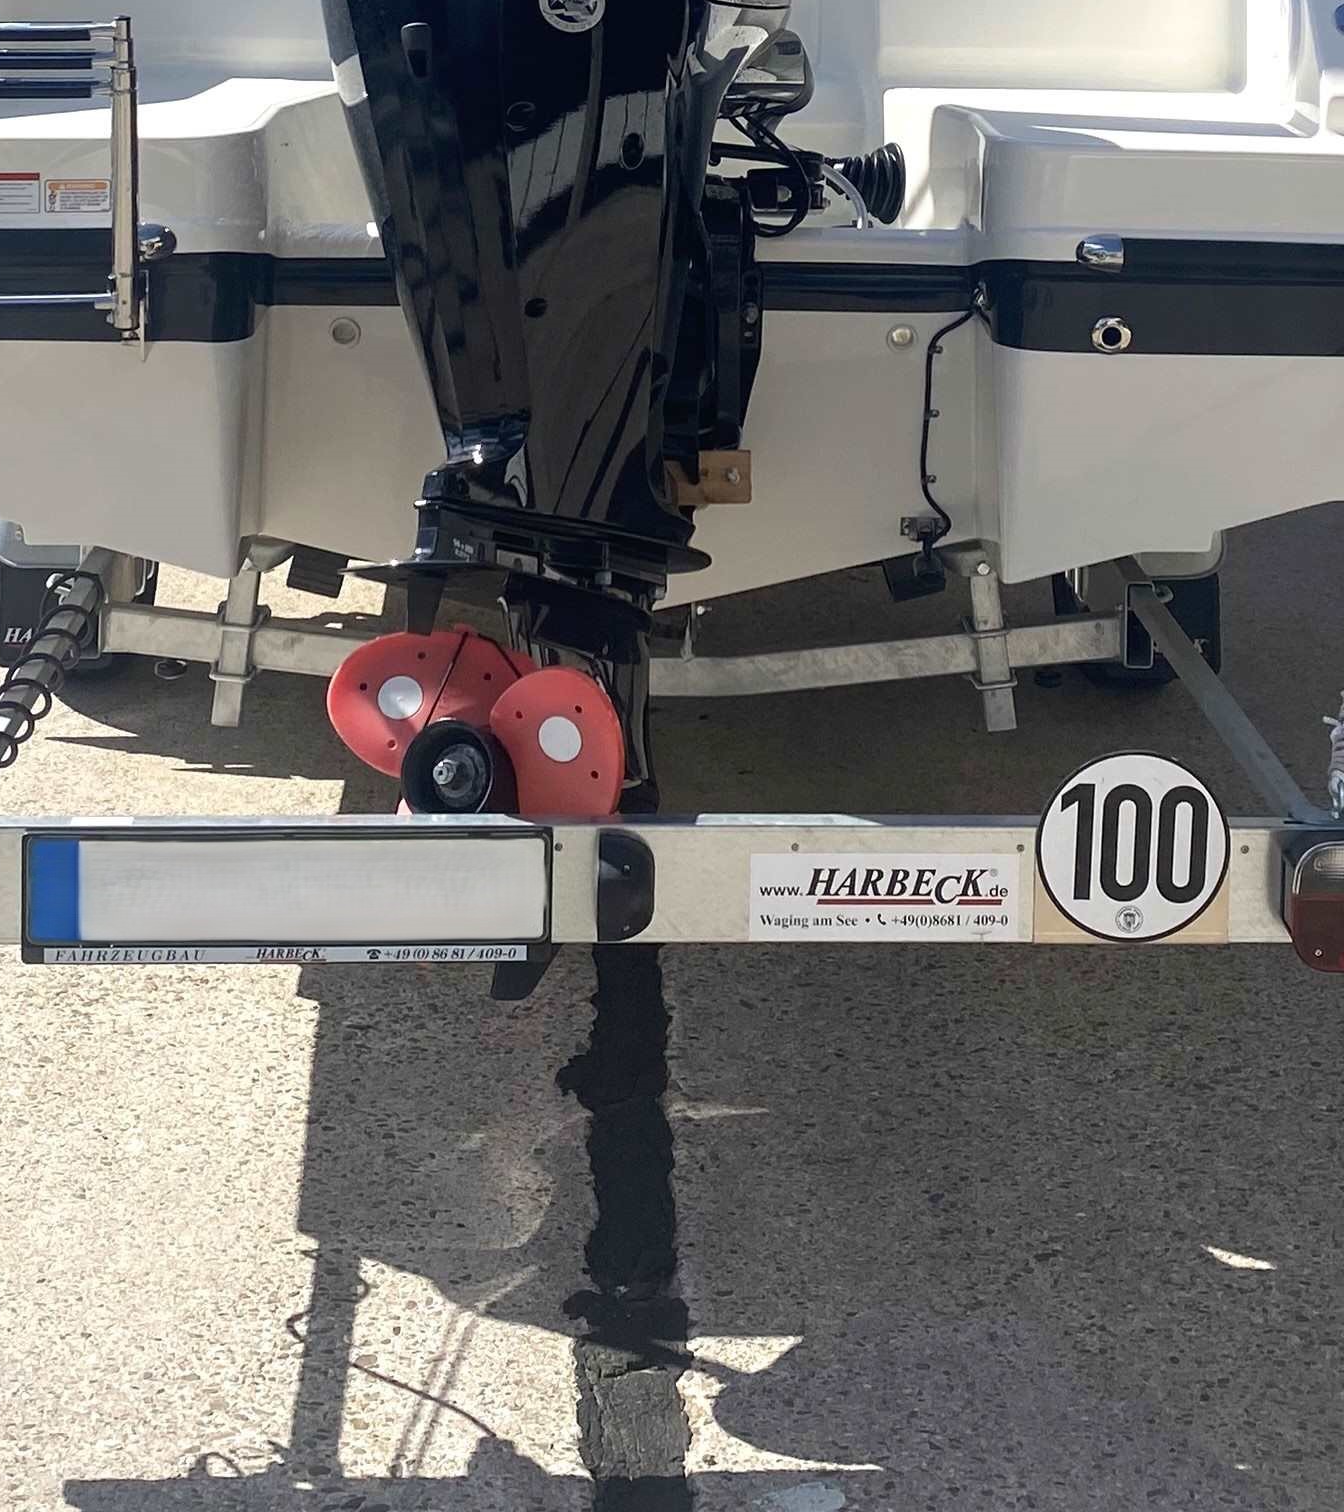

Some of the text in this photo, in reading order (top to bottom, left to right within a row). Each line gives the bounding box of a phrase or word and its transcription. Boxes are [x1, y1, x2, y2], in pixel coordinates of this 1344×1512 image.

[1060, 783, 1210, 904] 100
[760, 914, 809, 929] Waging
[813, 916, 833, 926] am
[836, 914, 859, 926] See
[891, 913, 962, 928] +49(0)8681
[973, 913, 1009, 927] 409-0
[55, 949, 206, 962] FAHRZEUGBAU
[255, 948, 321, 962] HARBECK
[476, 948, 517, 960] 409-0
